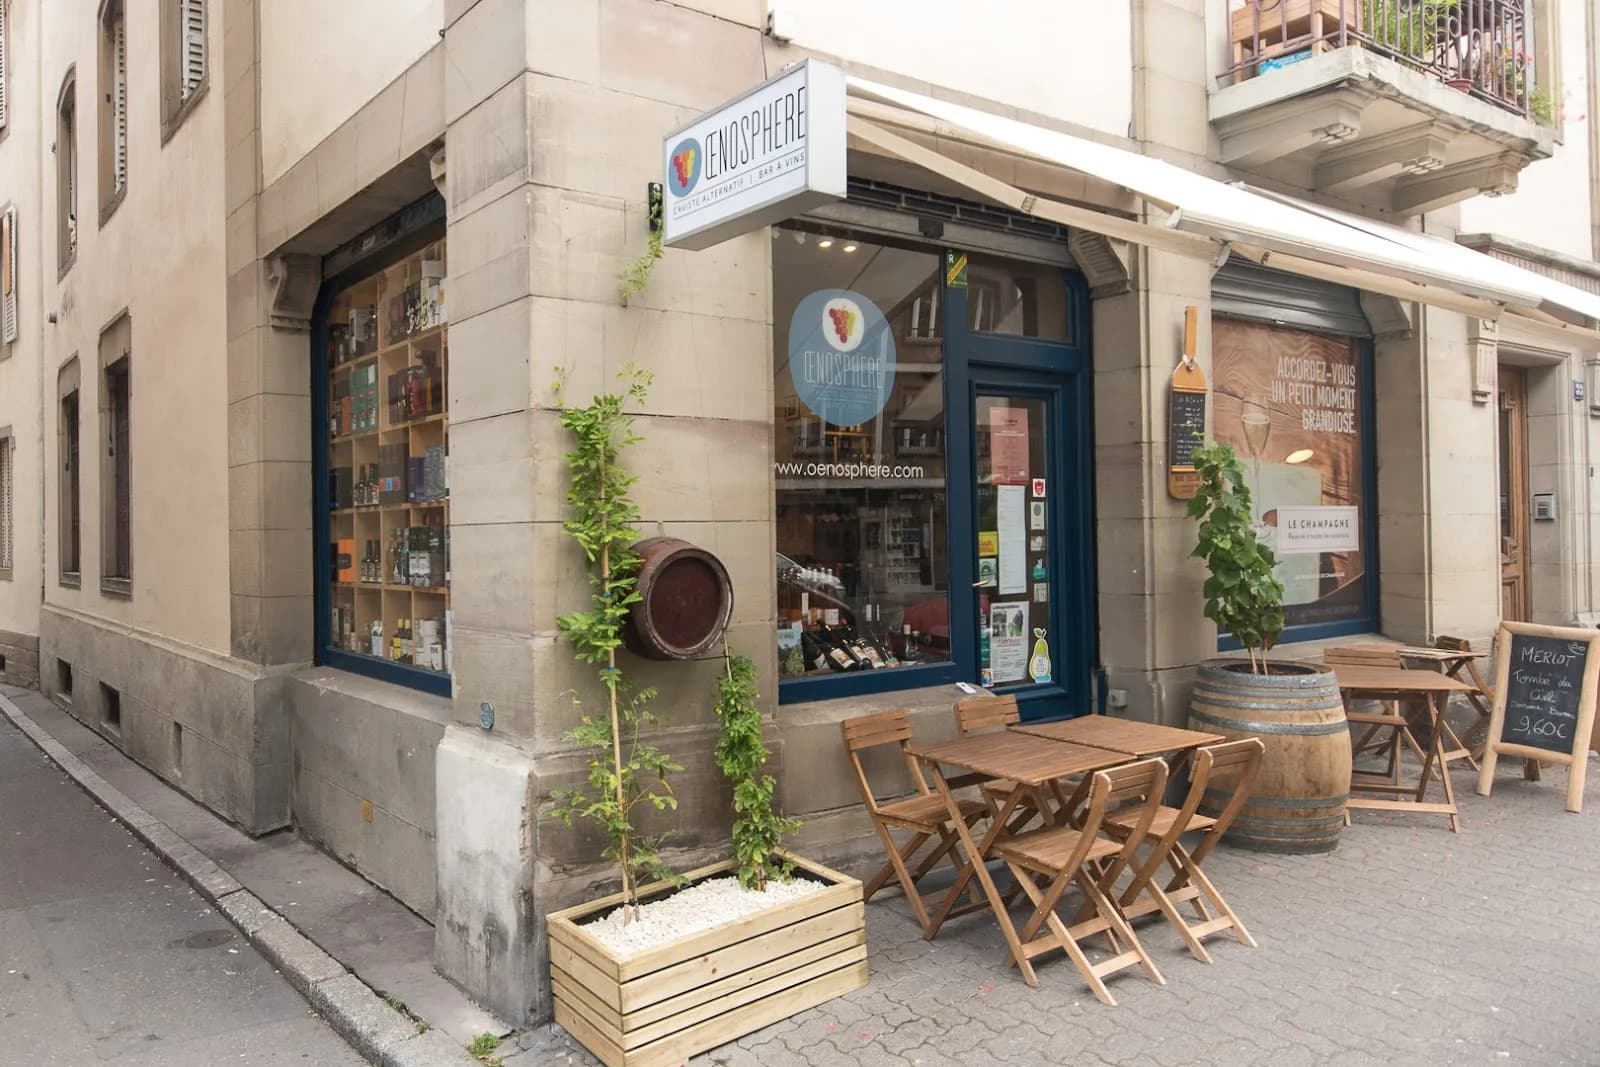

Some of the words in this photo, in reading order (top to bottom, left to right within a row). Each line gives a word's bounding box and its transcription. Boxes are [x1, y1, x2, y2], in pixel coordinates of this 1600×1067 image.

[705, 86, 805, 180] ŒNOSPHERE
[673, 198, 700, 216] CAVISTE
[702, 179, 744, 203] ALTERNATIF
[758, 165, 773, 179] BAR
[785, 151, 805, 168] VINS
[1277, 356, 1356, 385] ACCORDEZ-VOUS
[1272, 381, 1286, 402] UN
[1288, 384, 1314, 406] PETIT
[1316, 386, 1356, 410] MOMENT
[1302, 411, 1356, 434] GRANDIOSE.
[774, 461, 924, 480] ww.oenosphere.com
[1288, 520, 1297, 529] LE
[1300, 519, 1350, 529] CHAMPAGNE
[1521, 646, 1577, 667] MERLOT
